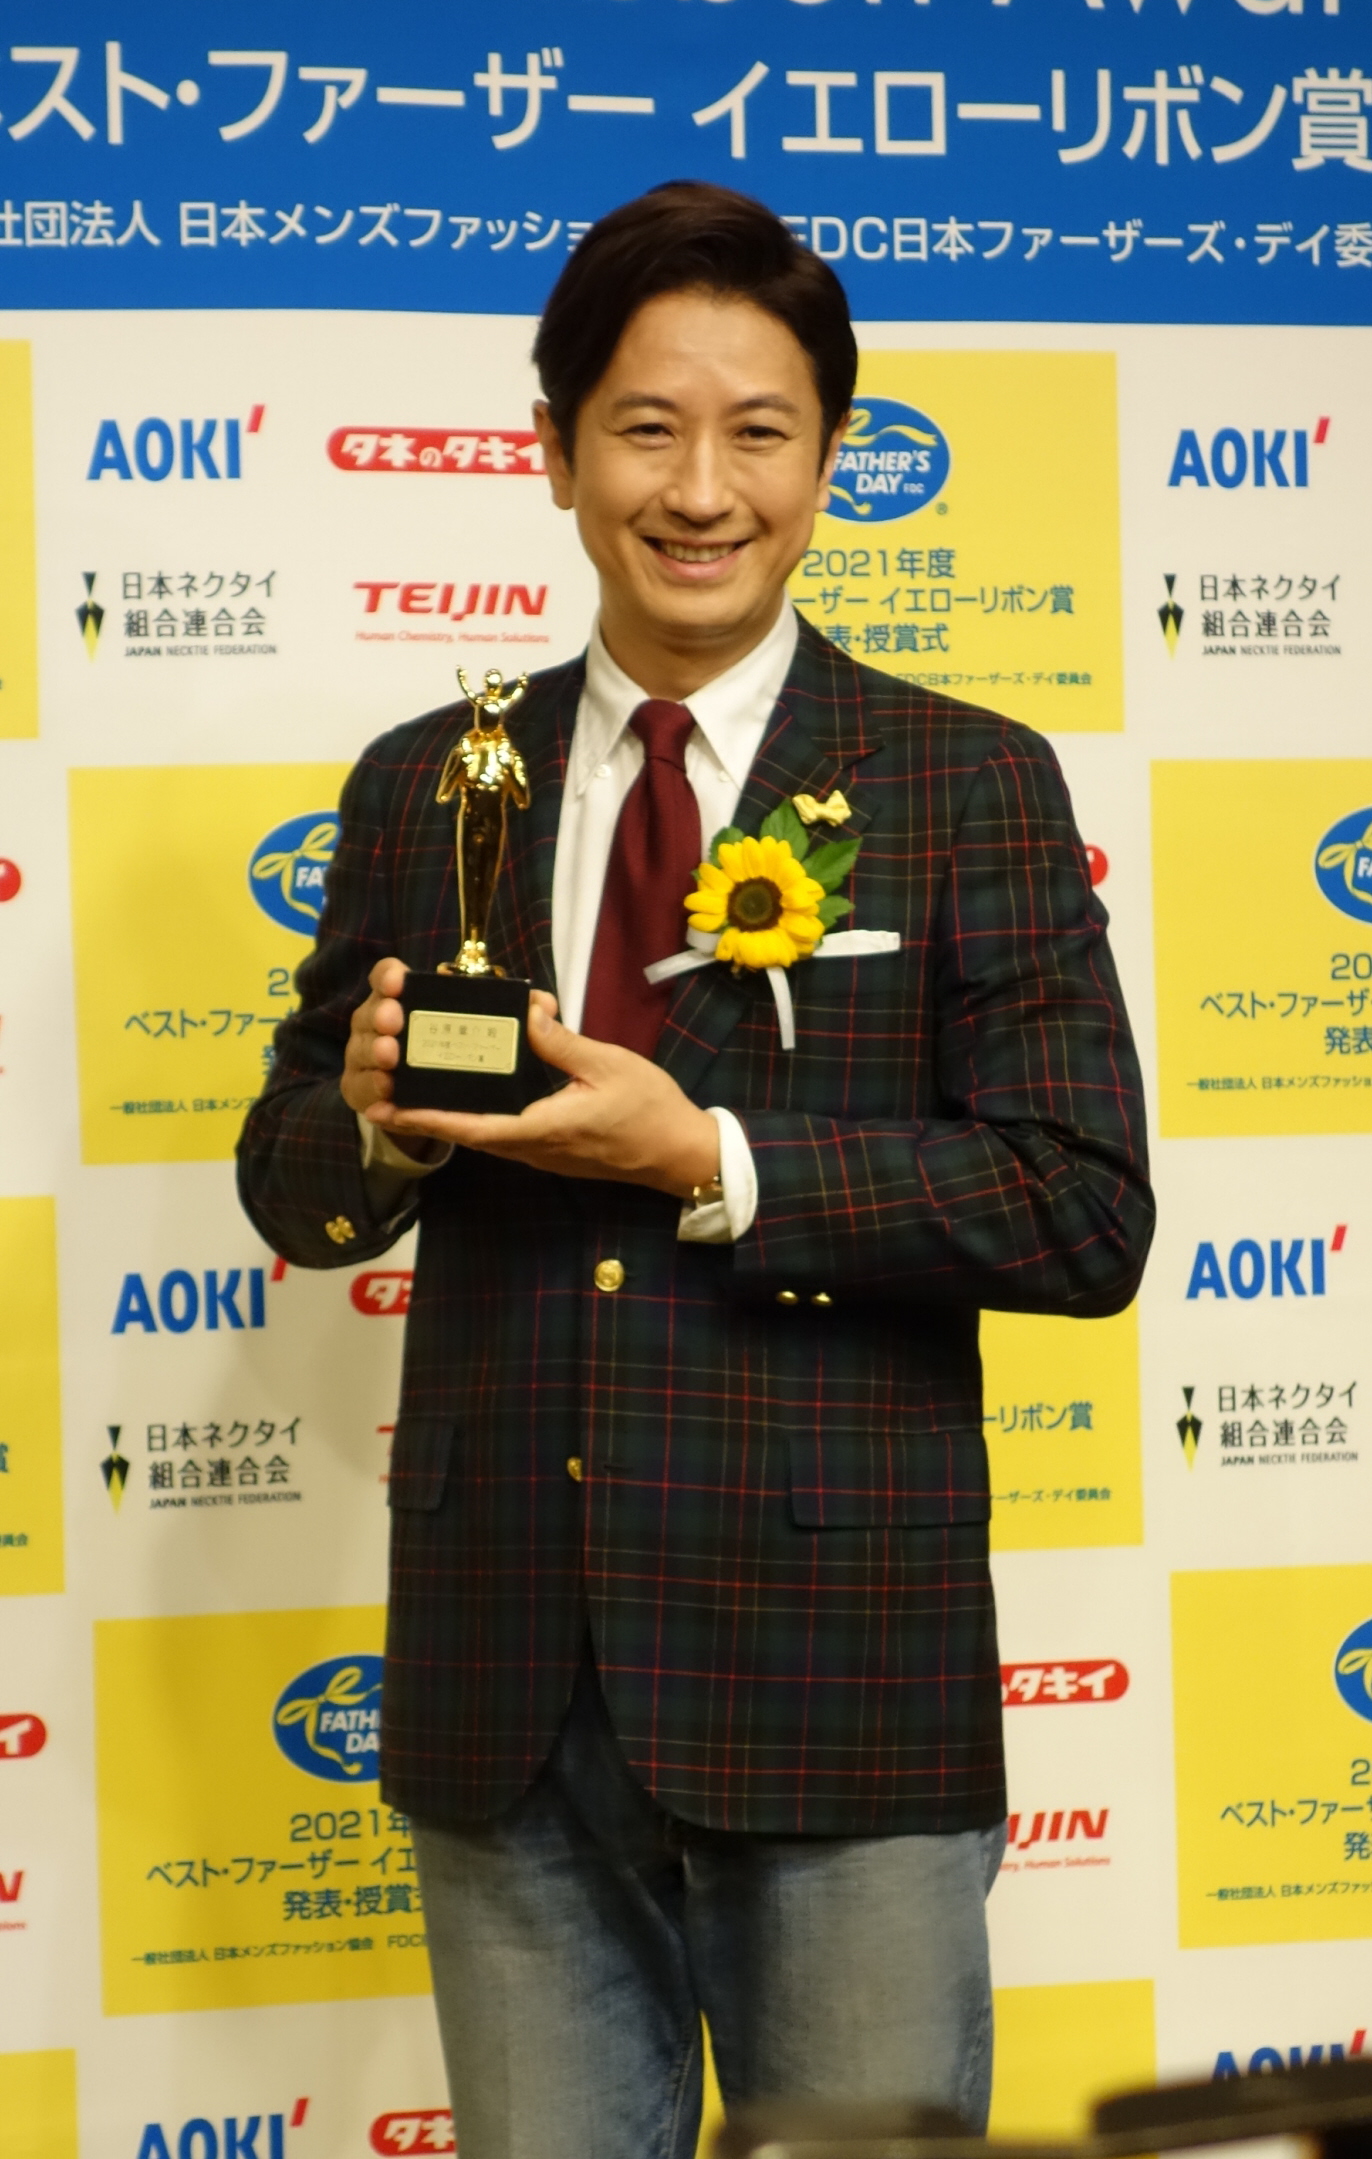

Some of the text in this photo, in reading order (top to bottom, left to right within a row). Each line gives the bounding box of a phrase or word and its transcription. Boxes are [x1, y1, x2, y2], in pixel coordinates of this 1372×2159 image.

[0, 40, 1372, 172] スト・ファーザー イエローリボン賞
[86, 415, 241, 481] AOKI
[341, 432, 546, 470] タネのタキイ
[833, 449, 931, 472] FATHER'S
[1168, 426, 1309, 487] AOKI
[855, 472, 903, 494] DAY
[803, 548, 956, 579] 2021年度
[122, 570, 277, 600] 日本ネクタイ
[880, 585, 1075, 615] イエローリボン賞
[1200, 573, 1341, 601] 日本ネクタイ
[353, 581, 548, 621] TEIJIN
[124, 607, 265, 638] 組合連合会
[817, 622, 949, 654] 表・授賞式
[1202, 609, 1331, 639] 組合連合会
[125, 644, 277, 656] JAPAN NECKTIE FEDERATION
[1202, 645, 1342, 656] JAPAN NECKTIE FEDERATION
[296, 866, 328, 887] FA
[1200, 987, 1372, 1019] ベスト・ファーザ
[125, 1006, 293, 1038] ベスト・ファー
[1186, 1237, 1325, 1300] AOKI
[111, 1267, 265, 1335] AOKI
[1218, 1381, 1358, 1412] 日本ネクタイ
[147, 1416, 302, 1453] 日本ネクタイ
[1220, 1416, 1347, 1448] 組合連合会
[149, 1455, 290, 1491] 組合連合会
[1220, 1452, 1358, 1467] JAPAN NECKTIE FEDERATION
[149, 1491, 302, 1509] JAPAN NECKTIE FEDERATION
[990, 1487, 1111, 1503] ーザーズ・デイ委員会
[1001, 1664, 1117, 1703] タキイ
[1220, 1796, 1372, 1827] ベスト・ファー
[147, 1848, 360, 1888] ベスト・ファーザー
[283, 1883, 421, 1921] 発表・授賞
[1281, 1881, 1372, 1897] 日本メンズファッ
